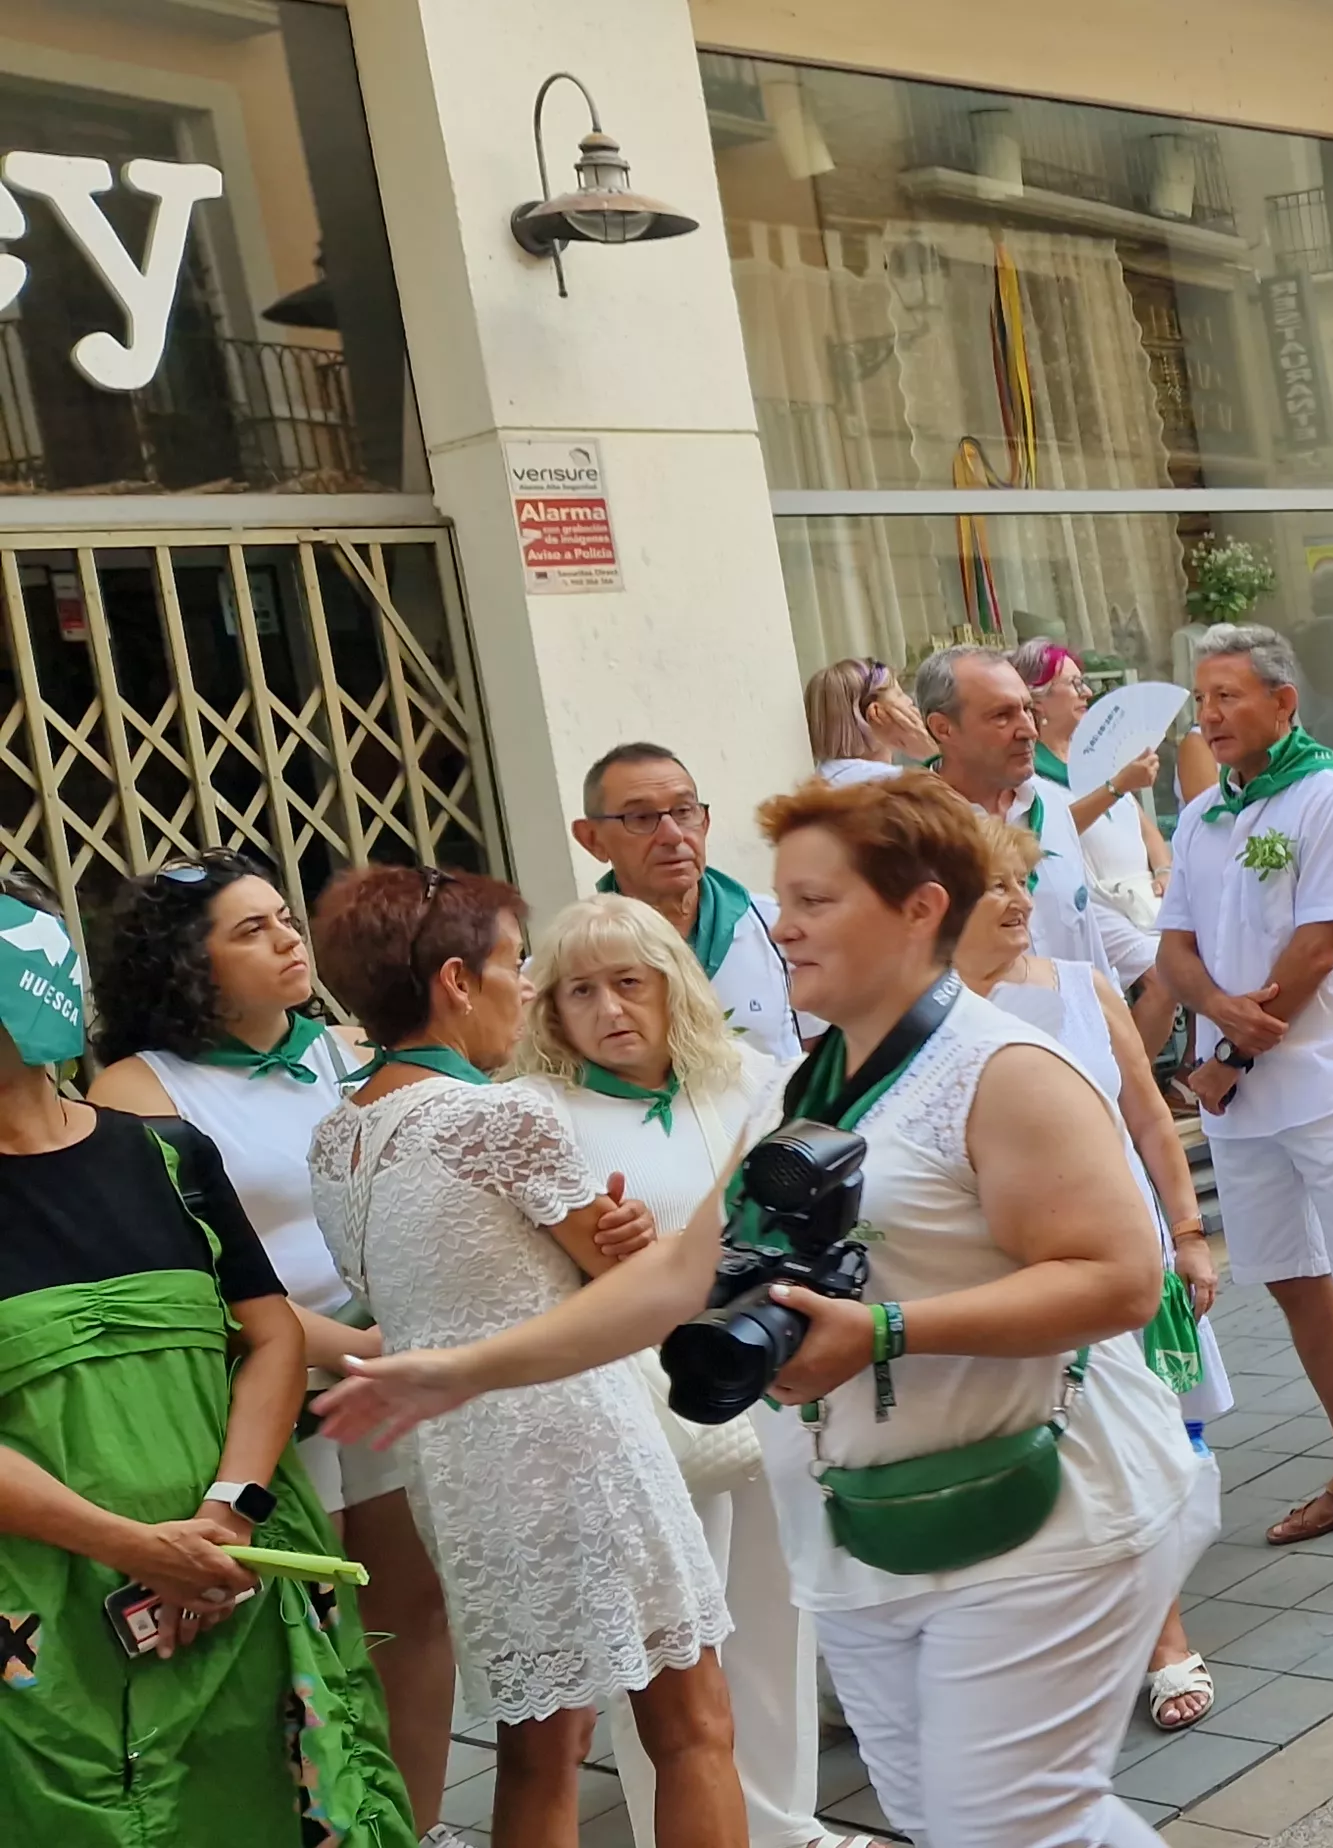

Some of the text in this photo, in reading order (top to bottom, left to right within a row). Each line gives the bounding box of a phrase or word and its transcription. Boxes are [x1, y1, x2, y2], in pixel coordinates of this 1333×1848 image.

[0, 150, 223, 391] y
[513, 468, 598, 481] verisure
[521, 501, 605, 522] Alarma
[19, 969, 79, 1026] HUESCA
